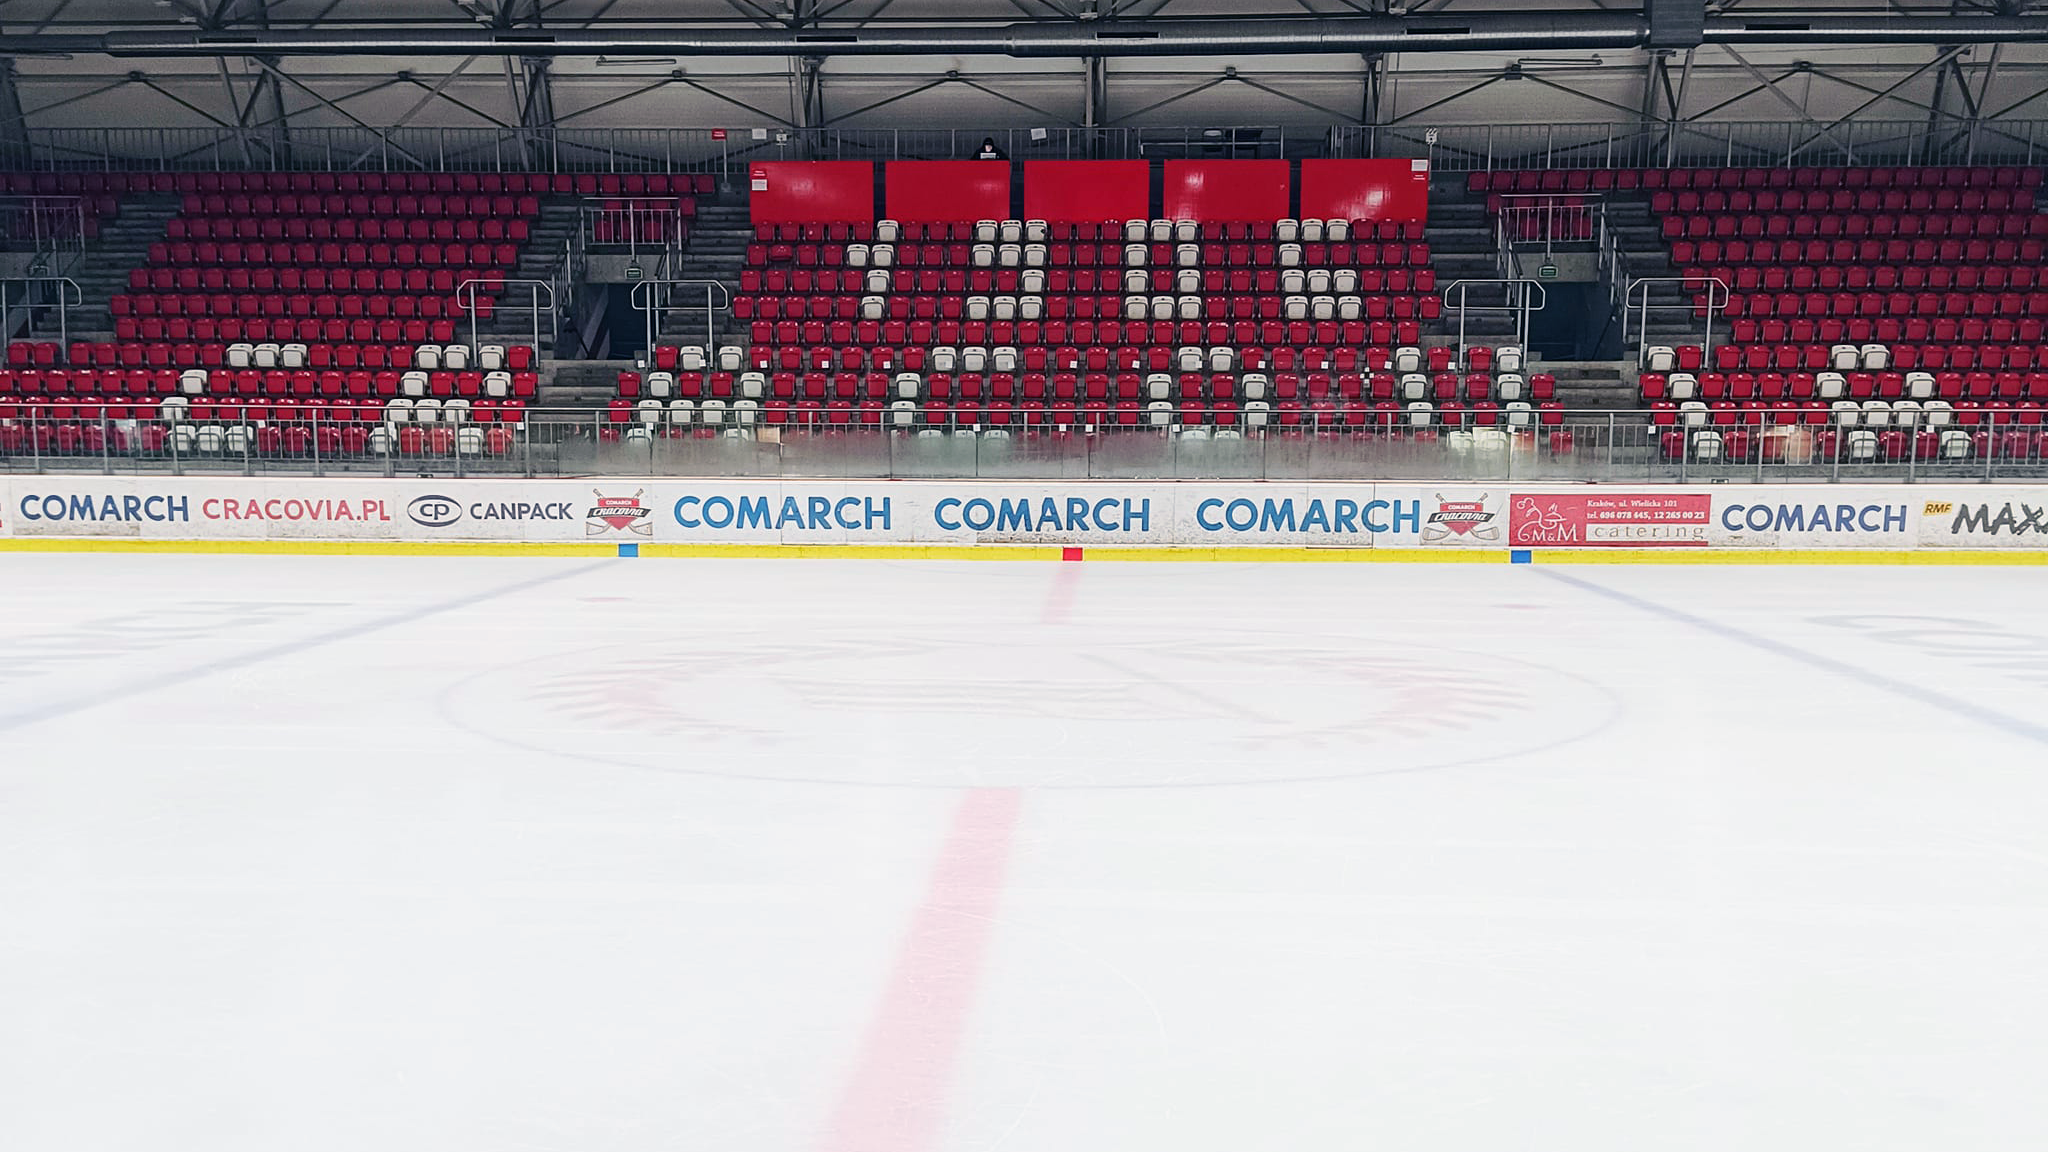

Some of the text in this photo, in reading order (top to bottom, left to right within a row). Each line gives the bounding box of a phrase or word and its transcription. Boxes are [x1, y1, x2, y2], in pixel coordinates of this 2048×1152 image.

[20, 494, 189, 521] COMARCH
[202, 498, 391, 521] CRACOVIA.PL
[470, 502, 574, 520] CANPACK
[674, 496, 891, 530] COMARCH
[934, 497, 1150, 532] COMARCH
[1196, 498, 1420, 533] COMARCH
[1654, 511, 1664, 519] 12
[1721, 504, 1907, 532] COMARCH
[1925, 503, 1951, 513] RMF
[1532, 523, 1578, 542] M&M
[1594, 526, 1705, 540] catering
